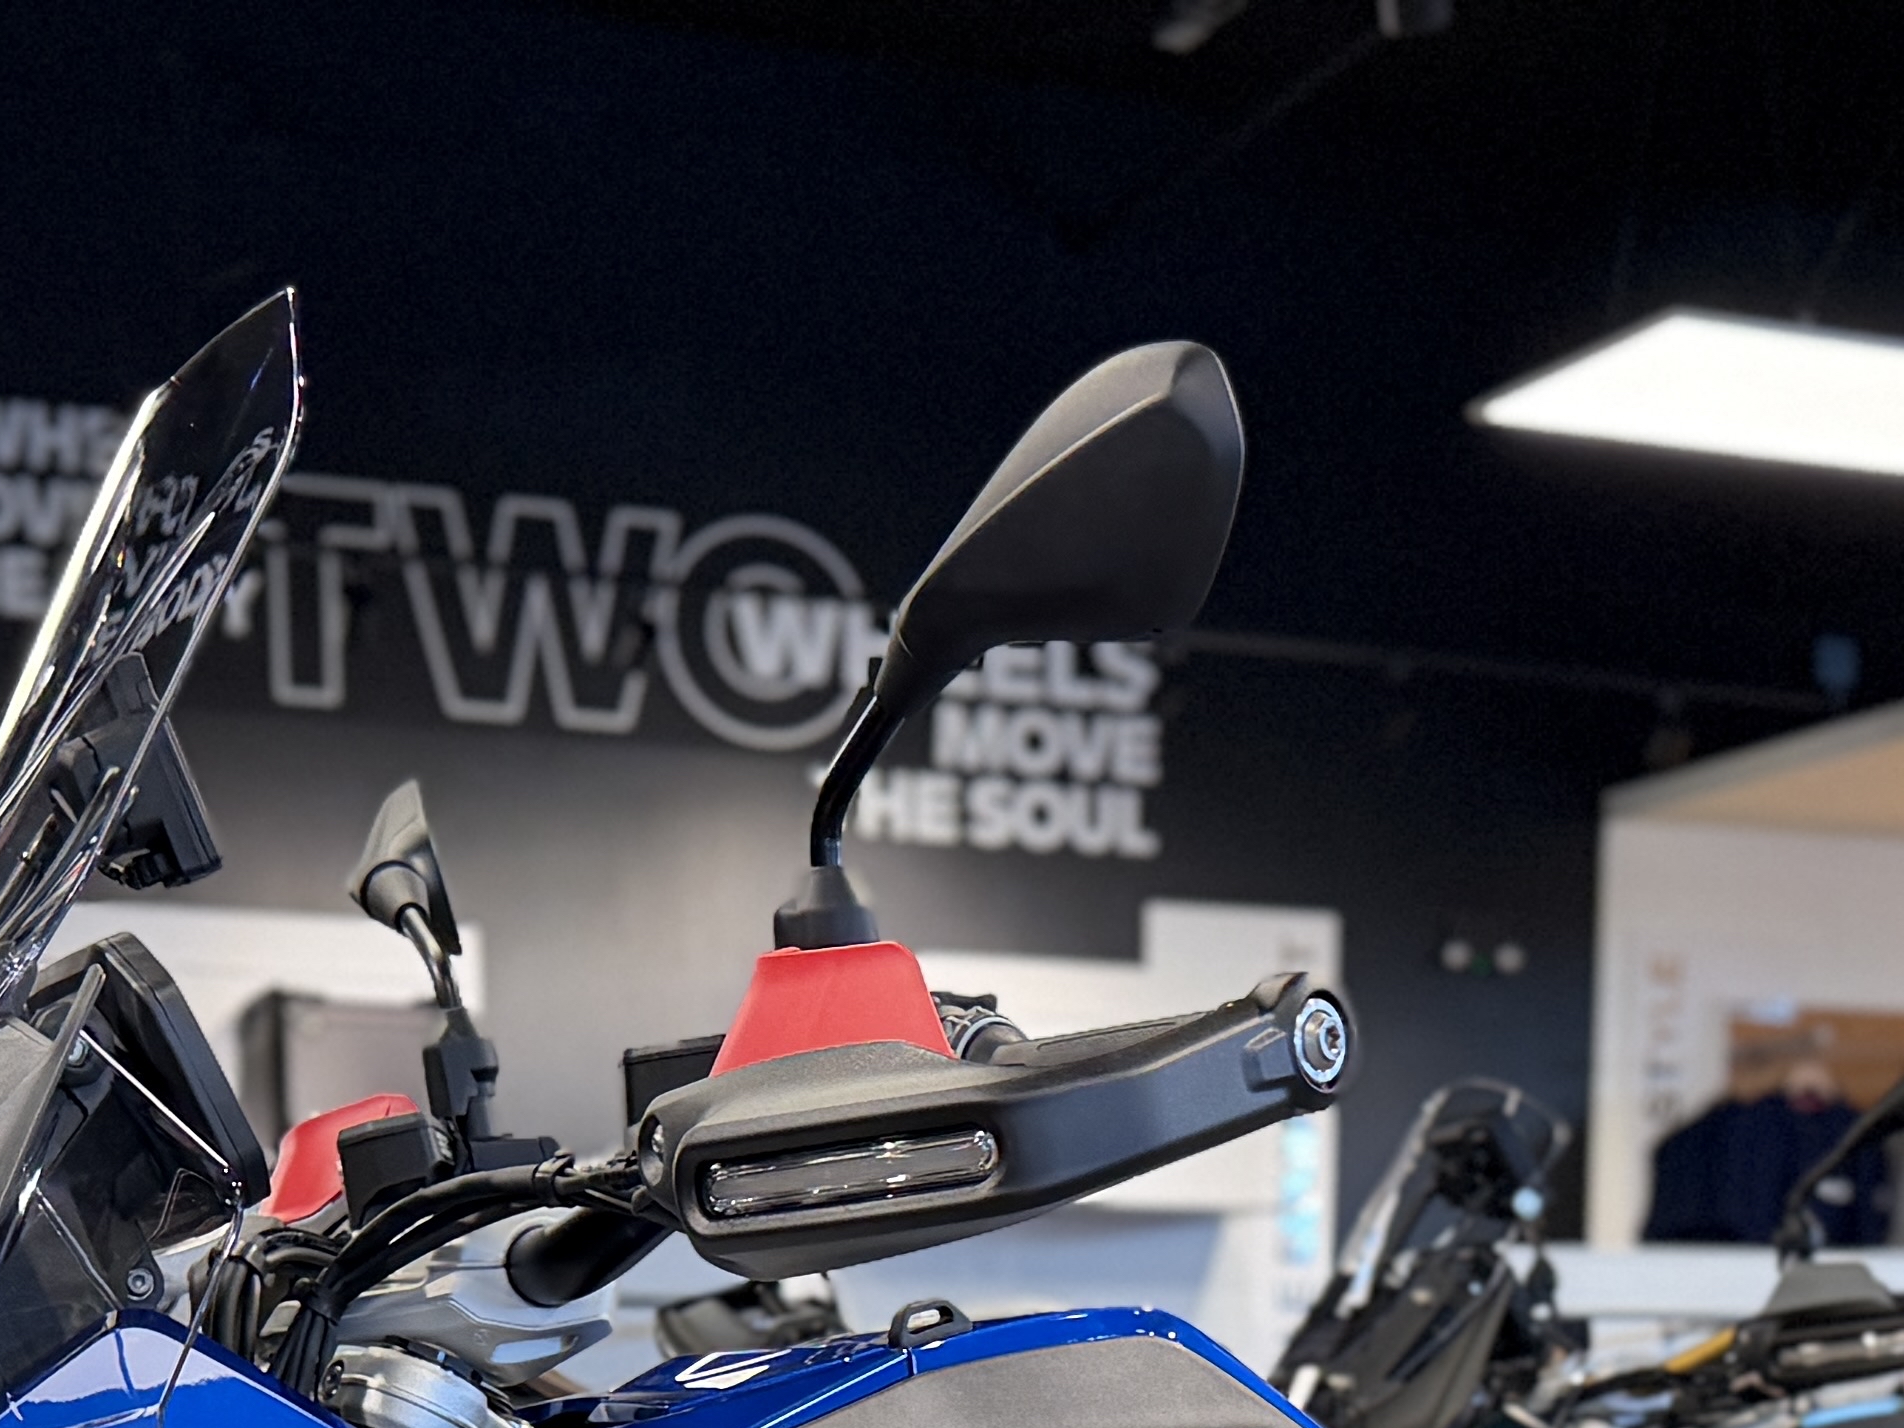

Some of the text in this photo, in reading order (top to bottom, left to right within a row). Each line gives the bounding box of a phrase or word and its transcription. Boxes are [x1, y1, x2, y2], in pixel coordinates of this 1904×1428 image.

[261, 472, 871, 752] TWO
[730, 592, 1158, 713] WHELS
[931, 702, 1163, 787] MOVE
[812, 762, 1162, 860] HE SOUL
